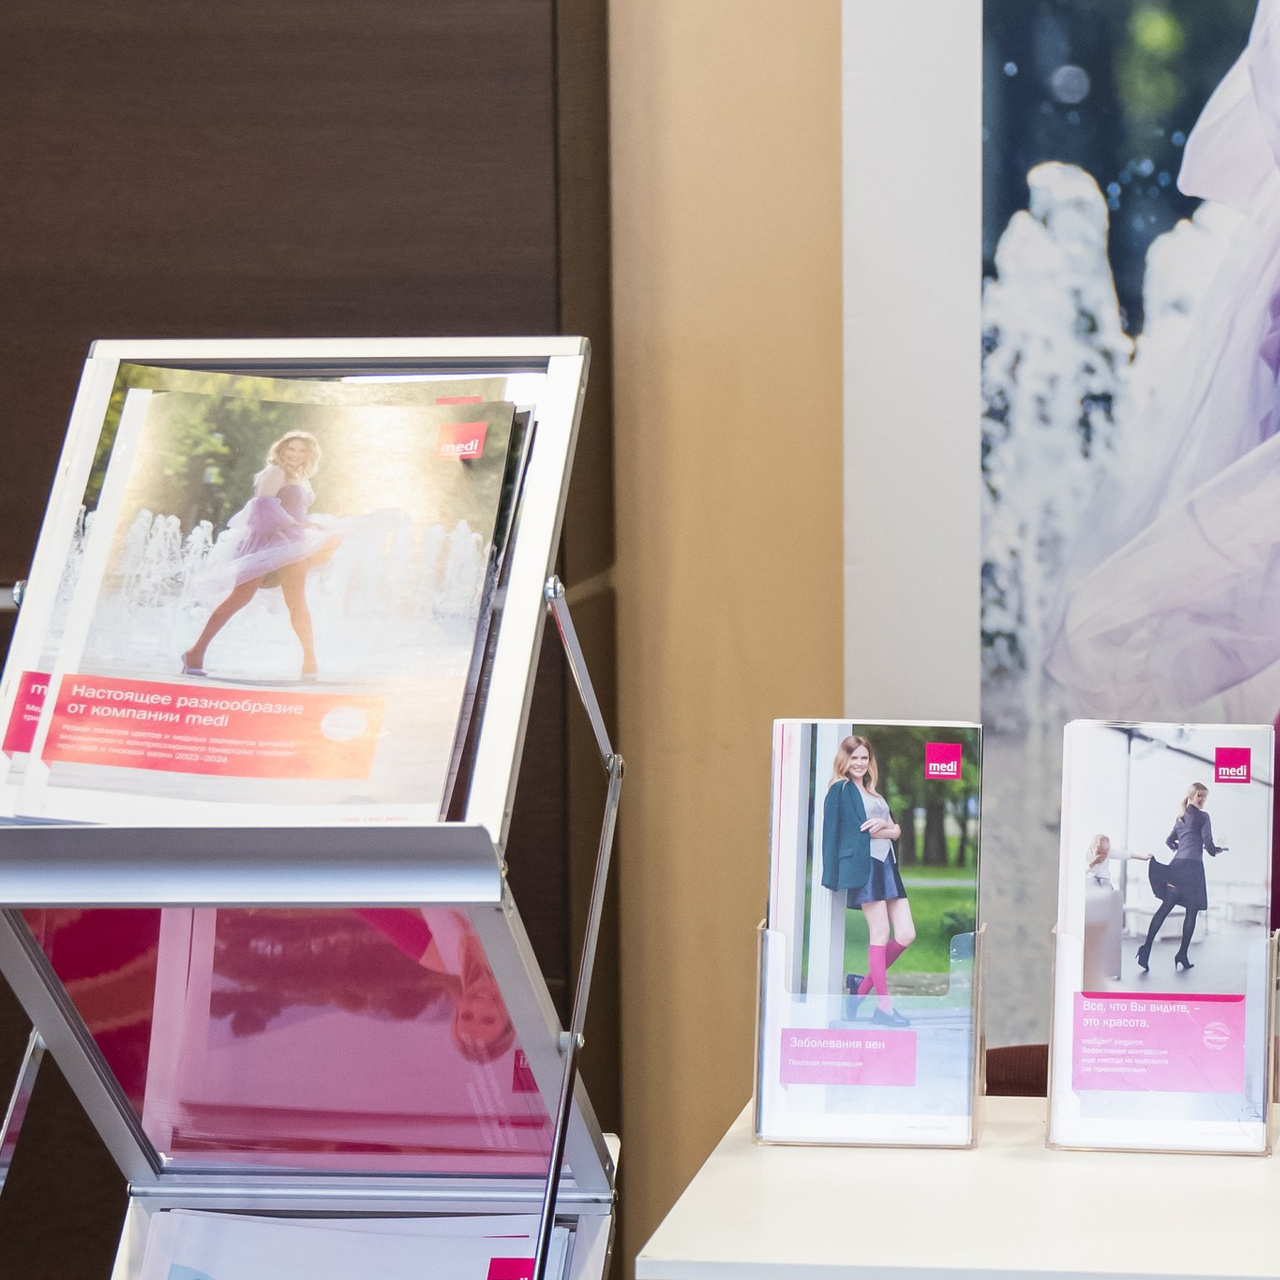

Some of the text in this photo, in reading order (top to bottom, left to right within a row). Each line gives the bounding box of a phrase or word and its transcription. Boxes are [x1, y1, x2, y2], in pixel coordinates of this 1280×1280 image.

[441, 438, 479, 452] medi
[71, 683, 172, 705] Настоящее
[176, 695, 305, 715] разнообразие
[66, 703, 230, 728] от компании medi
[929, 761, 957, 771] medi
[1218, 765, 1247, 776] medi
[1082, 1000, 1106, 1013] Все,
[1109, 1002, 1127, 1012] что
[1130, 1001, 1147, 1012] Вы
[1149, 1002, 1190, 1015] видите,
[1082, 1017, 1150, 1030] это красота.
[789, 1036, 886, 1050] Заболевания вен
